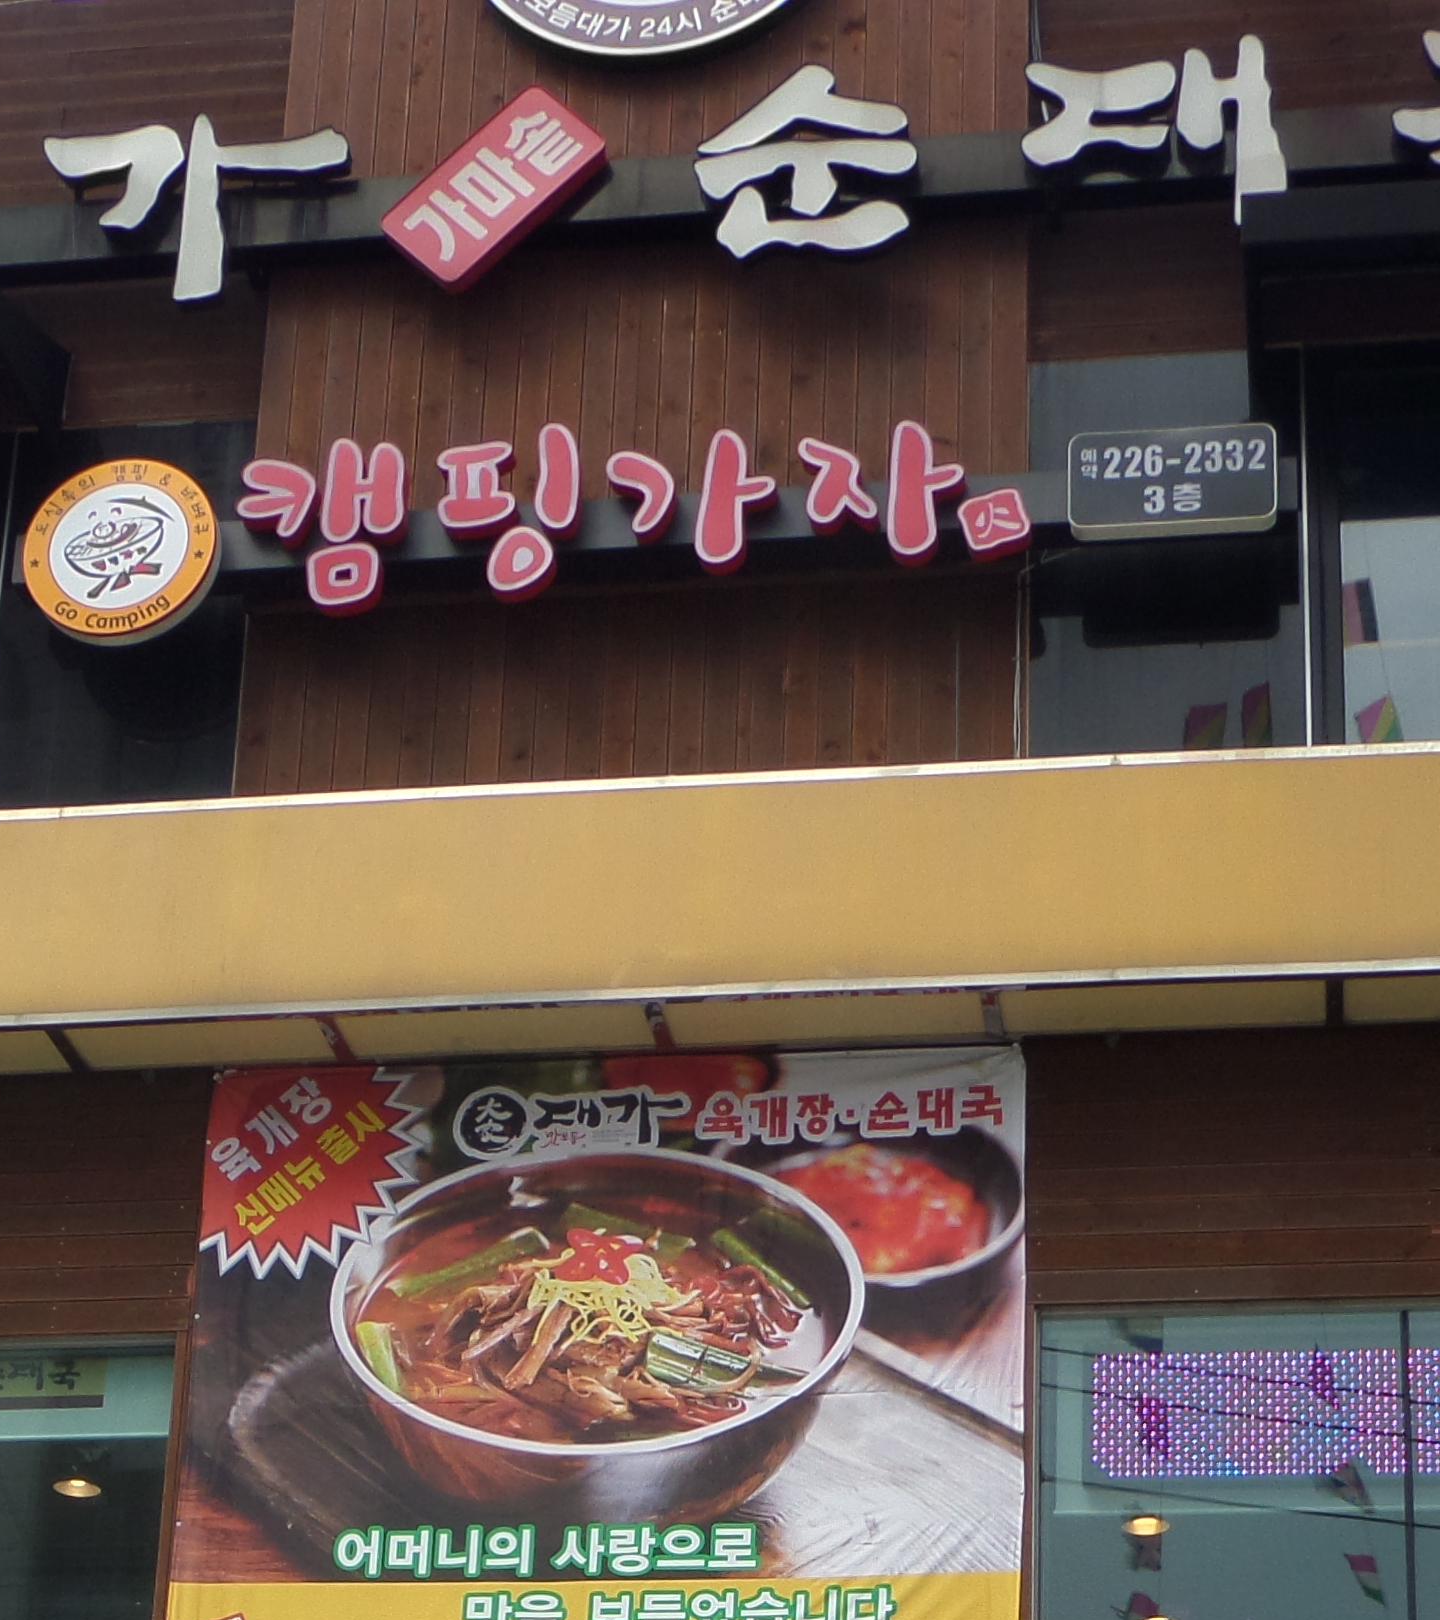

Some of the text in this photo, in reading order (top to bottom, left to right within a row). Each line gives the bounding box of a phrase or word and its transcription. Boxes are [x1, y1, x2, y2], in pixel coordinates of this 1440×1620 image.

[639, 7, 702, 38] 24시
[402, 109, 584, 263] 가마솥
[110, 464, 149, 483] 캠핑
[1103, 438, 1267, 480] 226-2332
[237, 420, 964, 607] 캠핑가자
[1142, 482, 1203, 514] 3층
[54, 594, 171, 629] Go Camping
[211, 1076, 332, 1181] 육개장
[234, 1100, 386, 1236] 신메뉴 출시
[336, 1524, 758, 1576] 어머니의 사랑으로
